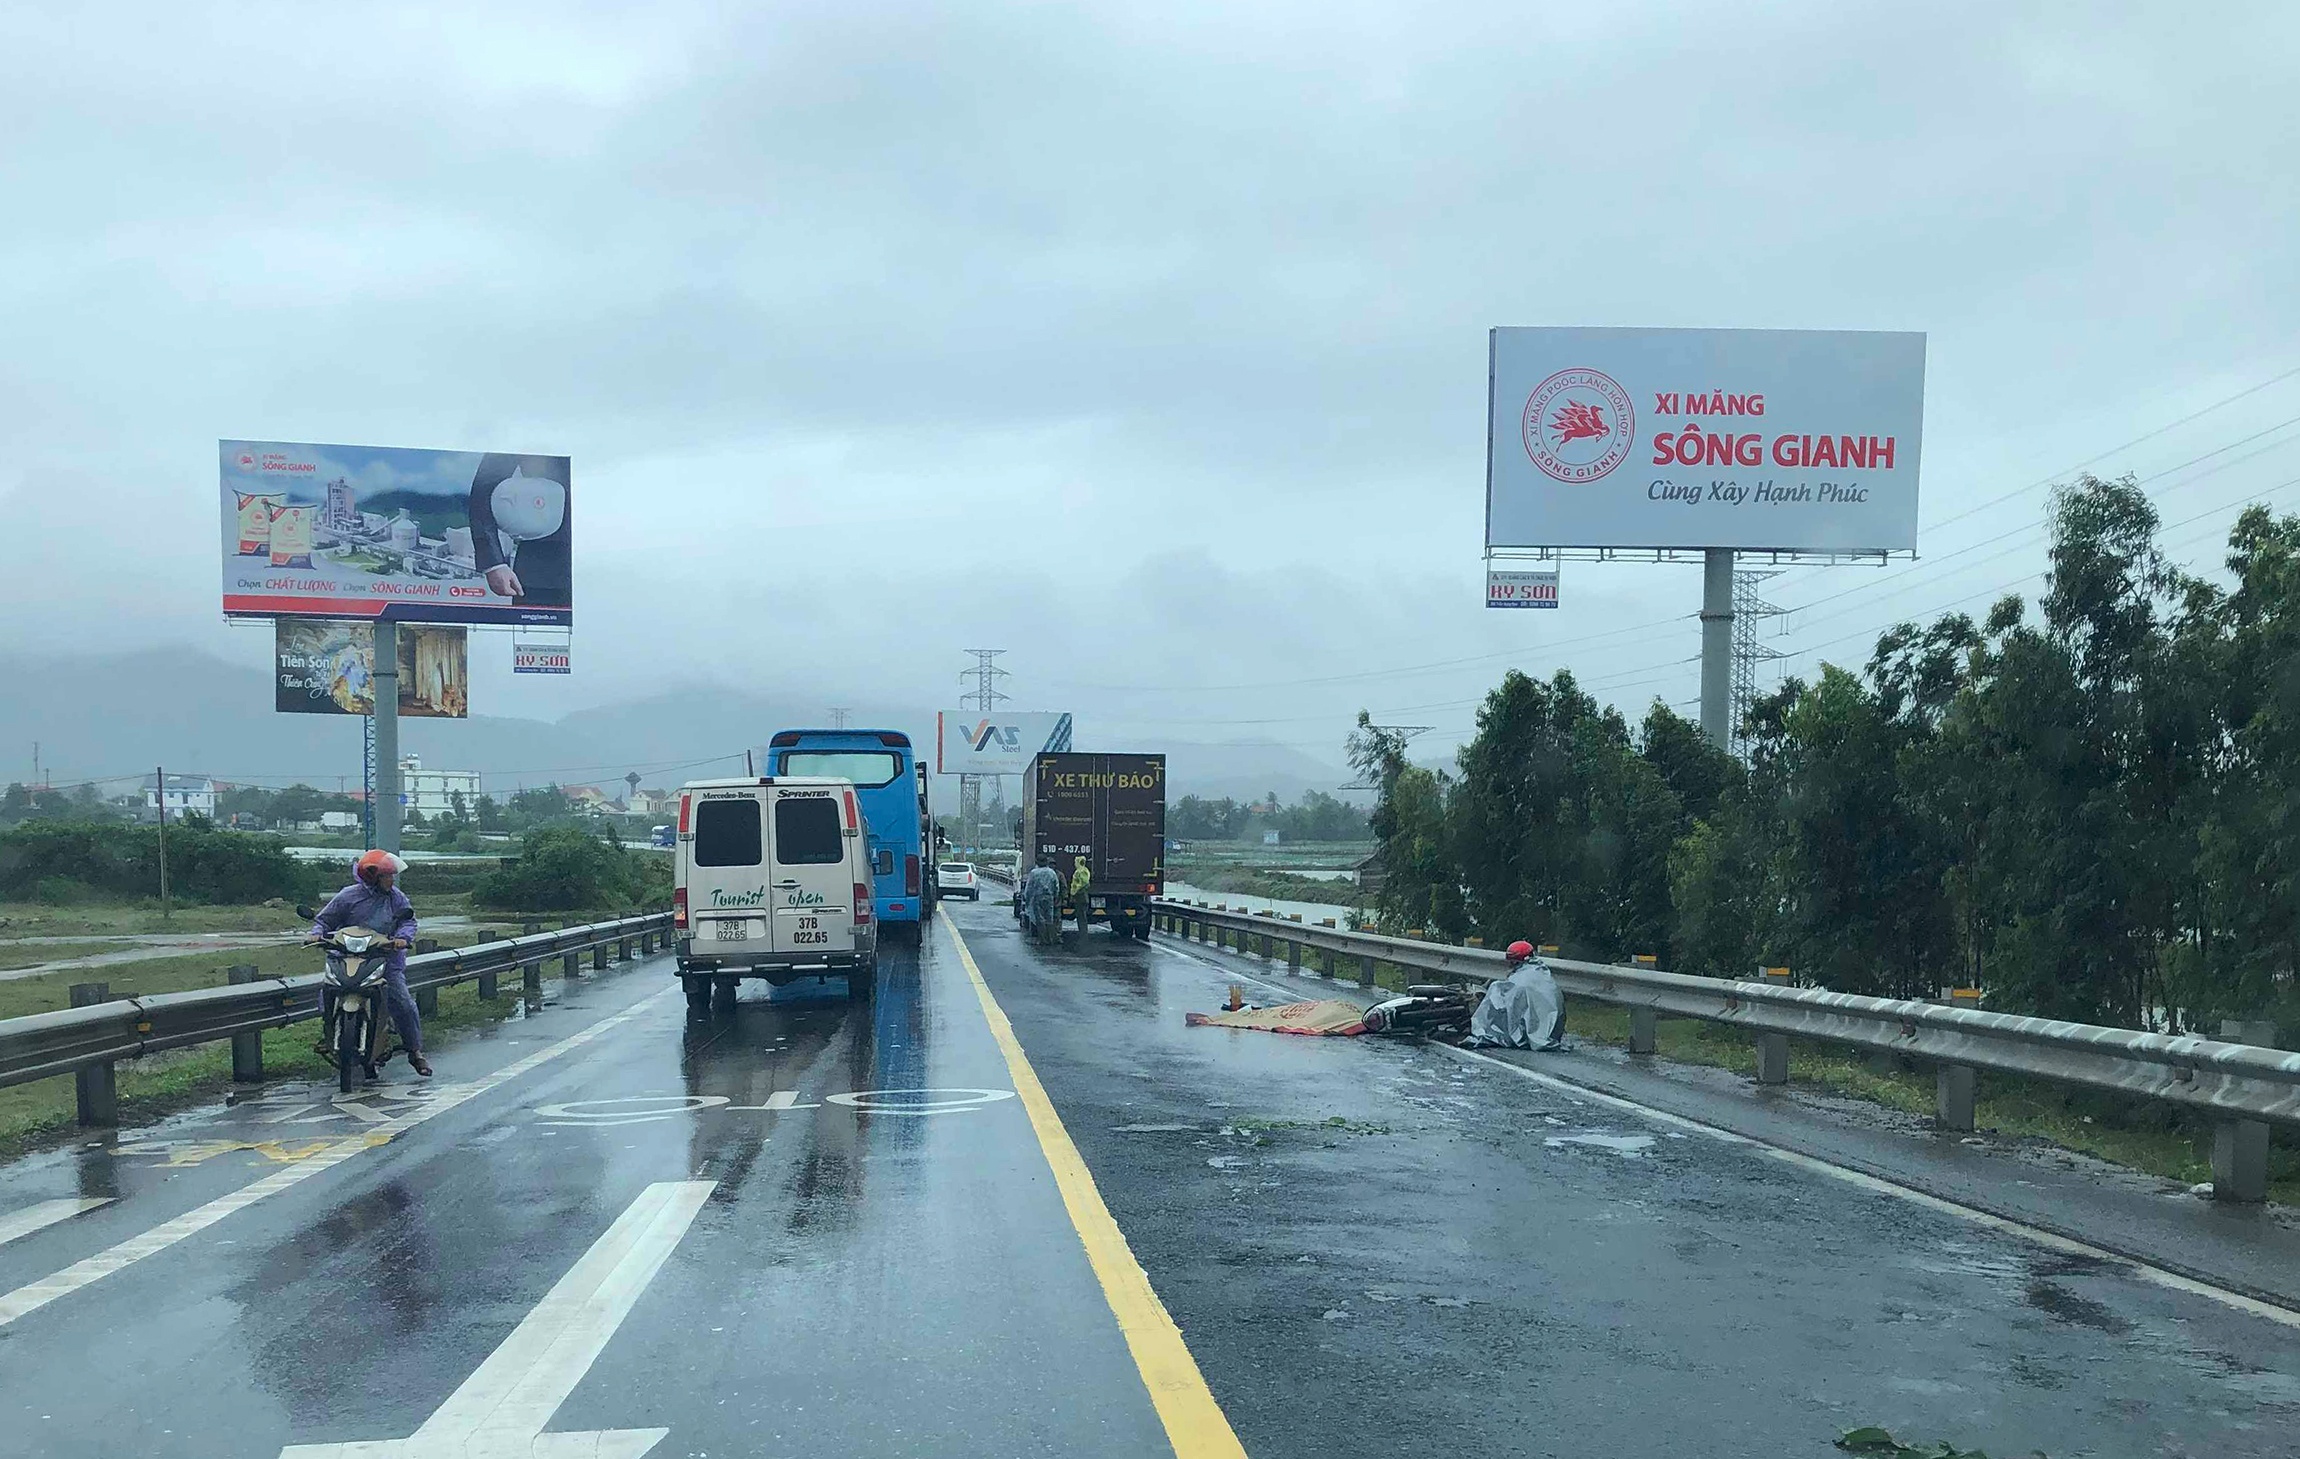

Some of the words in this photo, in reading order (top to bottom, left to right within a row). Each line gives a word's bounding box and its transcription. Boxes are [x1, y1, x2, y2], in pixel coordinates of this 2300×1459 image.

[1655, 393, 1679, 414] XI
[1686, 389, 1764, 415] MĂNG
[1653, 423, 1762, 466] SÔNG
[1772, 435, 1895, 468] GIANH
[262, 461, 287, 471] SÔNG
[1576, 452, 1618, 477] GIANH
[1648, 480, 1702, 505] Cùng
[1708, 481, 1749, 505] Xây
[1754, 481, 1811, 506] Hạnh
[1817, 482, 1869, 503] Phúc
[238, 579, 261, 591] Chọn
[265, 575, 295, 590] CHẤT
[298, 579, 336, 592] LƯỢNG
[370, 581, 402, 595] SÔNG
[404, 584, 441, 596] GIANH
[1054, 773, 1075, 787] XE
[1078, 773, 1115, 788] THƯ
[702, 792, 755, 800] Mercedes-Benz
[711, 885, 765, 907] Tourist
[789, 890, 824, 912] open
[724, 921, 739, 930] 37B
[799, 917, 818, 929] 37B
[718, 931, 745, 939] 022.65
[794, 932, 828, 943] 022.65
